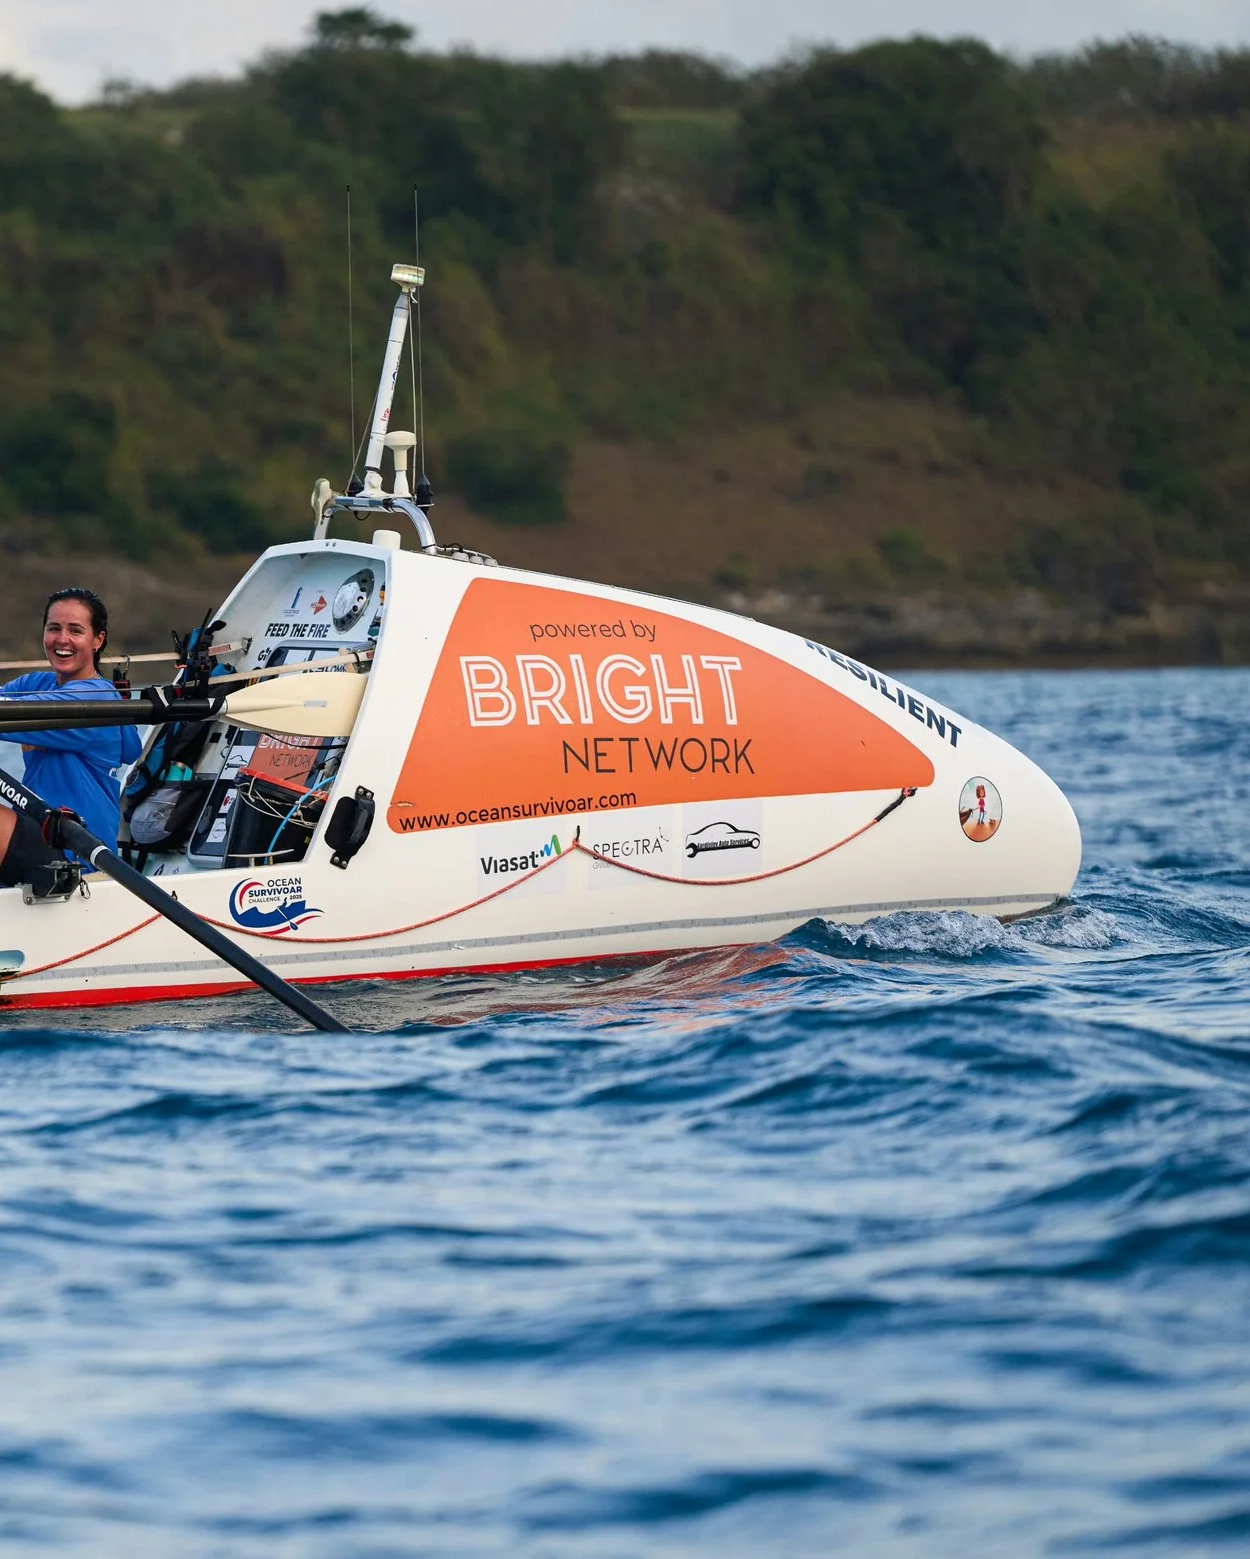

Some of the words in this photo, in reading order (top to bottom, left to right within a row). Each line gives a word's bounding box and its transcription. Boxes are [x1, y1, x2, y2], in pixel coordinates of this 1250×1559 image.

[265, 623, 290, 637] FEED
[290, 623, 309, 638] THE
[308, 624, 331, 638] FIRE
[529, 619, 627, 643] powered
[630, 619, 657, 643] by
[459, 653, 743, 727] BRIGHT
[269, 753, 313, 768] NETWORK
[562, 736, 755, 775] NETWORK
[399, 791, 638, 832] www.oceansurvivoar.com
[592, 838, 664, 861] SPECTRA
[480, 851, 540, 876] Viasat
[248, 886, 303, 897] SURVIVOAR
[267, 877, 302, 888] OCEAN
[248, 896, 281, 904] CHALLENGE
